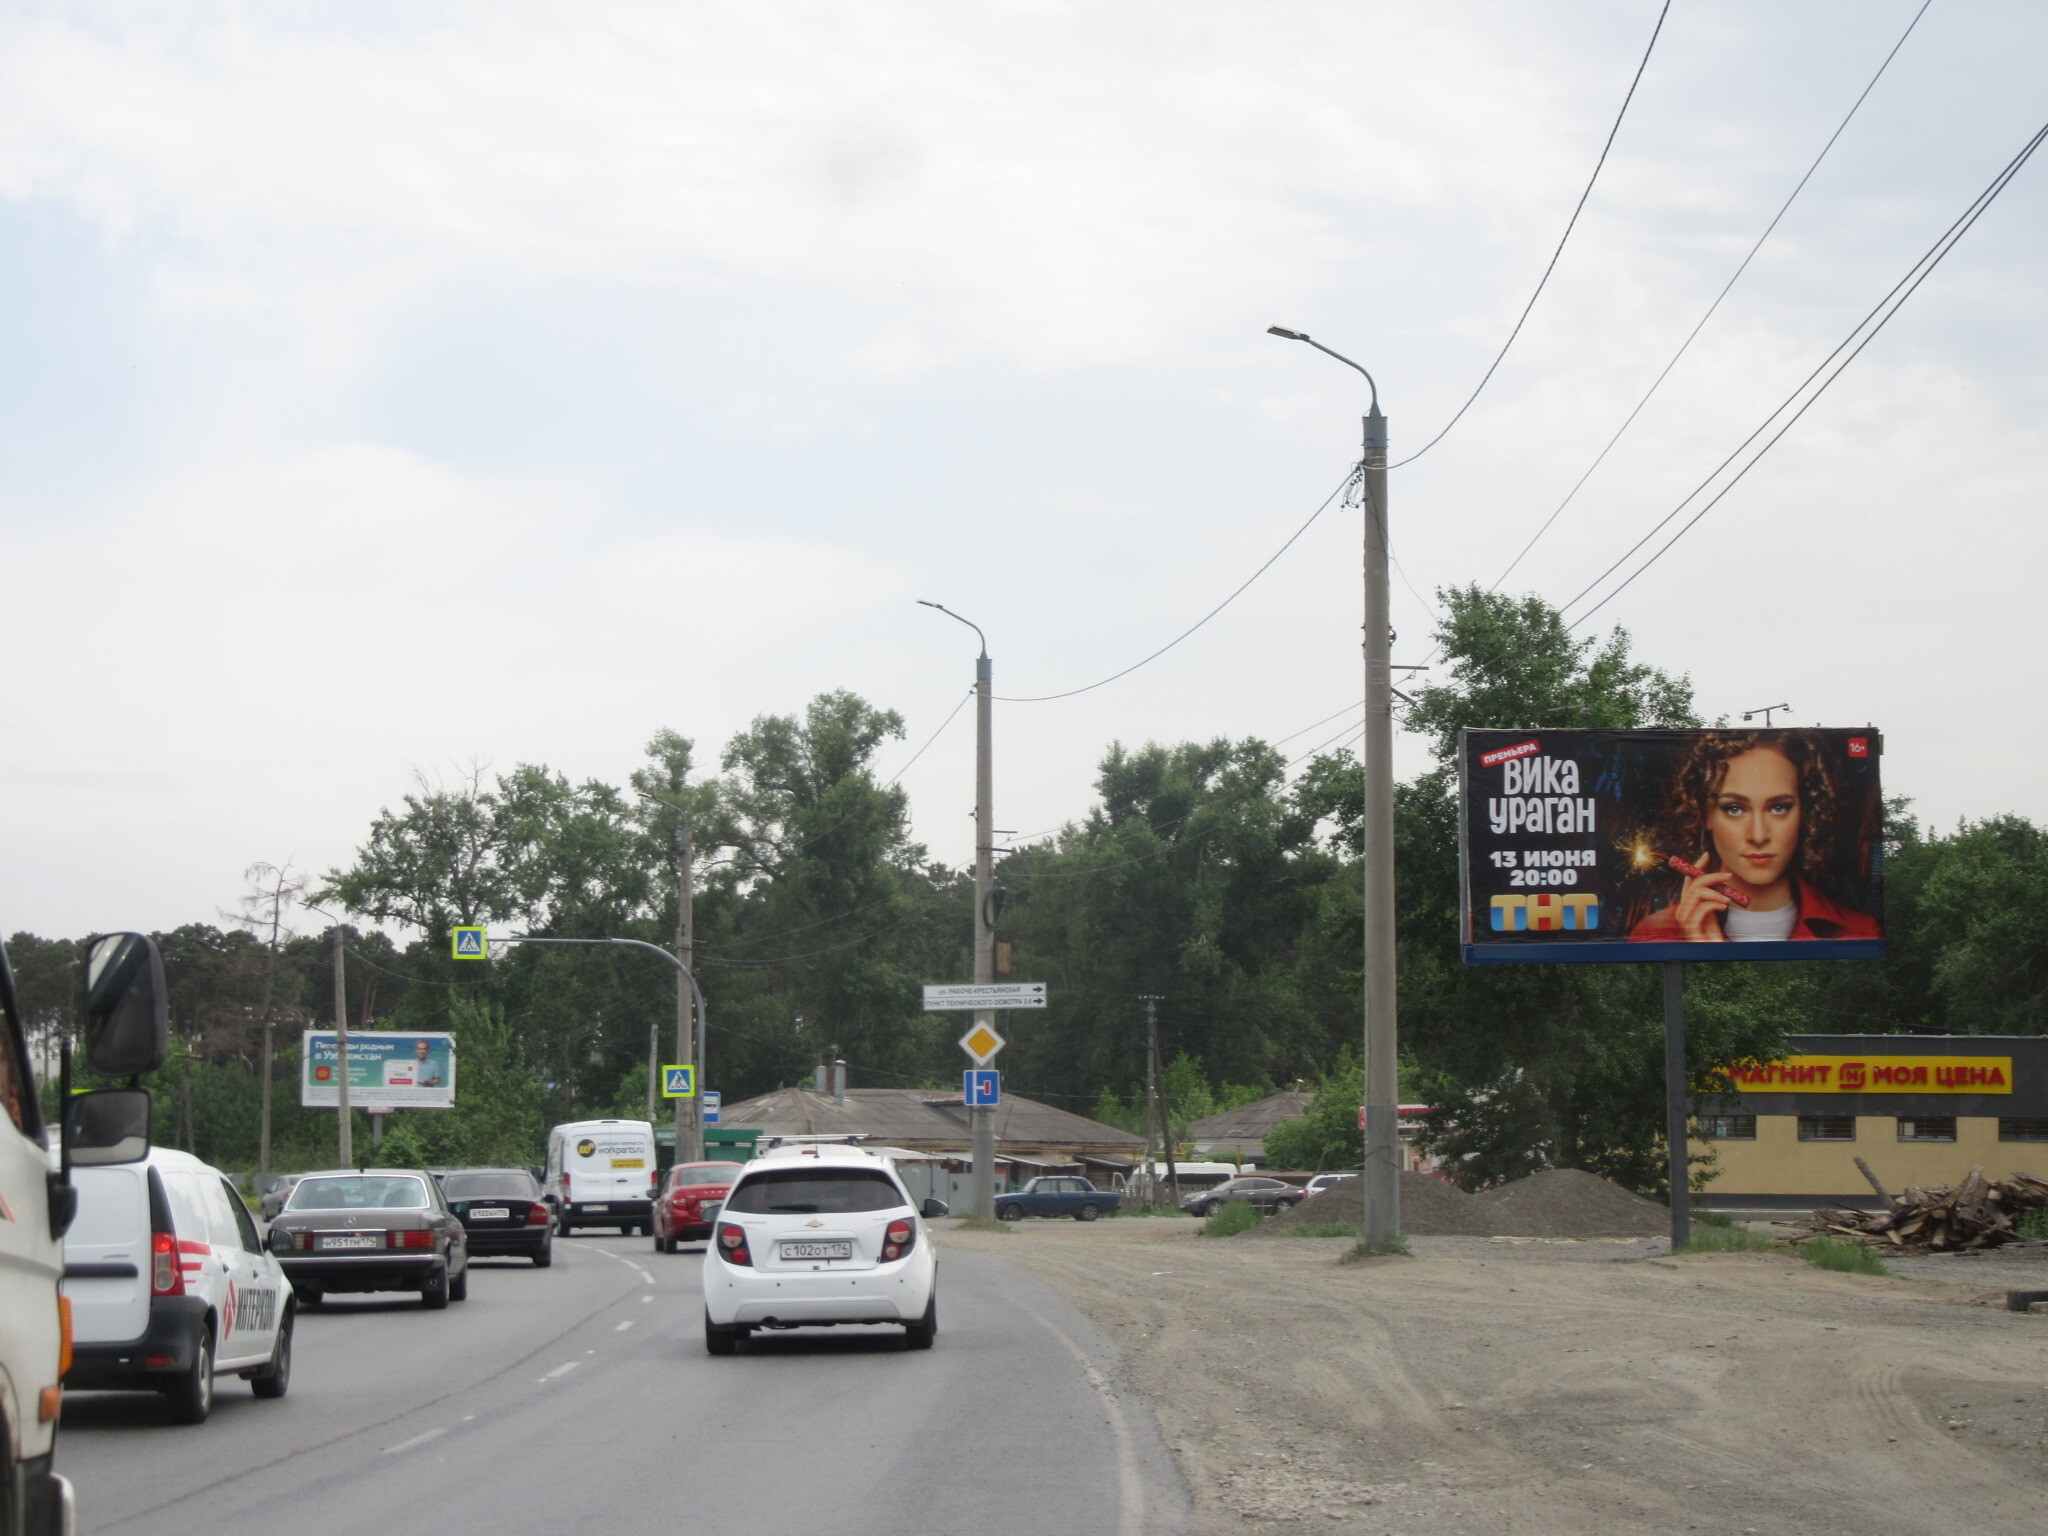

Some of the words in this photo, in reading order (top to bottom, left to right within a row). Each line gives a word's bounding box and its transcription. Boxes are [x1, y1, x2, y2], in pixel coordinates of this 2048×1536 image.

[1483, 743, 1537, 764] ПРЕМЬЕРА
[1849, 742, 1866, 753] 16+
[1489, 851, 1518, 868] 13
[1523, 850, 1597, 867] ИЮНЯ
[1509, 869, 1578, 886] 20:00
[1490, 894, 1599, 931] ТНТ
[949, 986, 1021, 995] РАБОЧЕ-КРЕСТЬЯНСКАЯ
[946, 999, 994, 1007] ТЕХНИЧЕСКОГО
[1728, 1064, 1832, 1084] МАГНИТ
[1873, 1066, 1928, 1084] МОЯ
[1936, 1067, 2006, 1087] ЦЕНА
